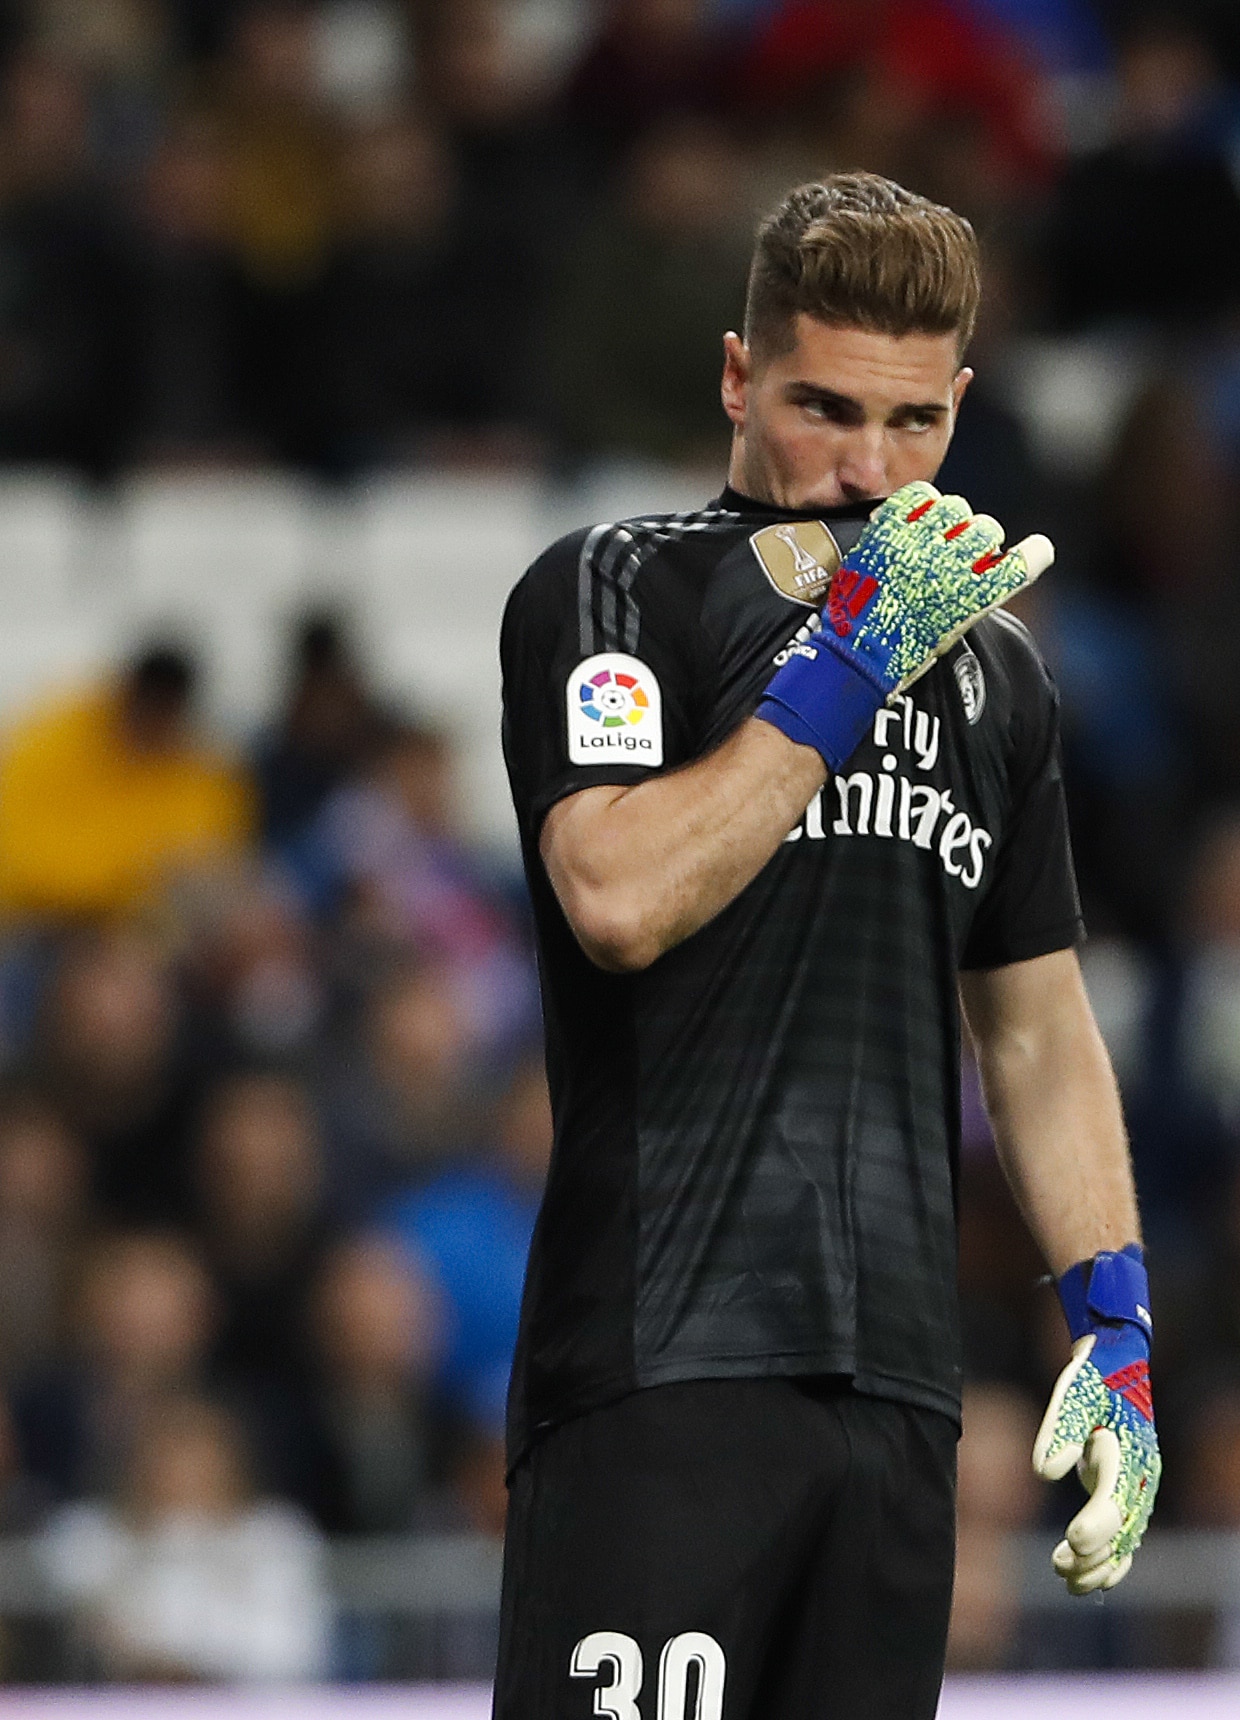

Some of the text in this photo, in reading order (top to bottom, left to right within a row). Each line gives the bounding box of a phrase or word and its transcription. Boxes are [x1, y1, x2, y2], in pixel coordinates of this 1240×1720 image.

[794, 566, 829, 587] FIFA
[580, 732, 652, 750] LaLiga
[569, 1631, 727, 1720] 30
